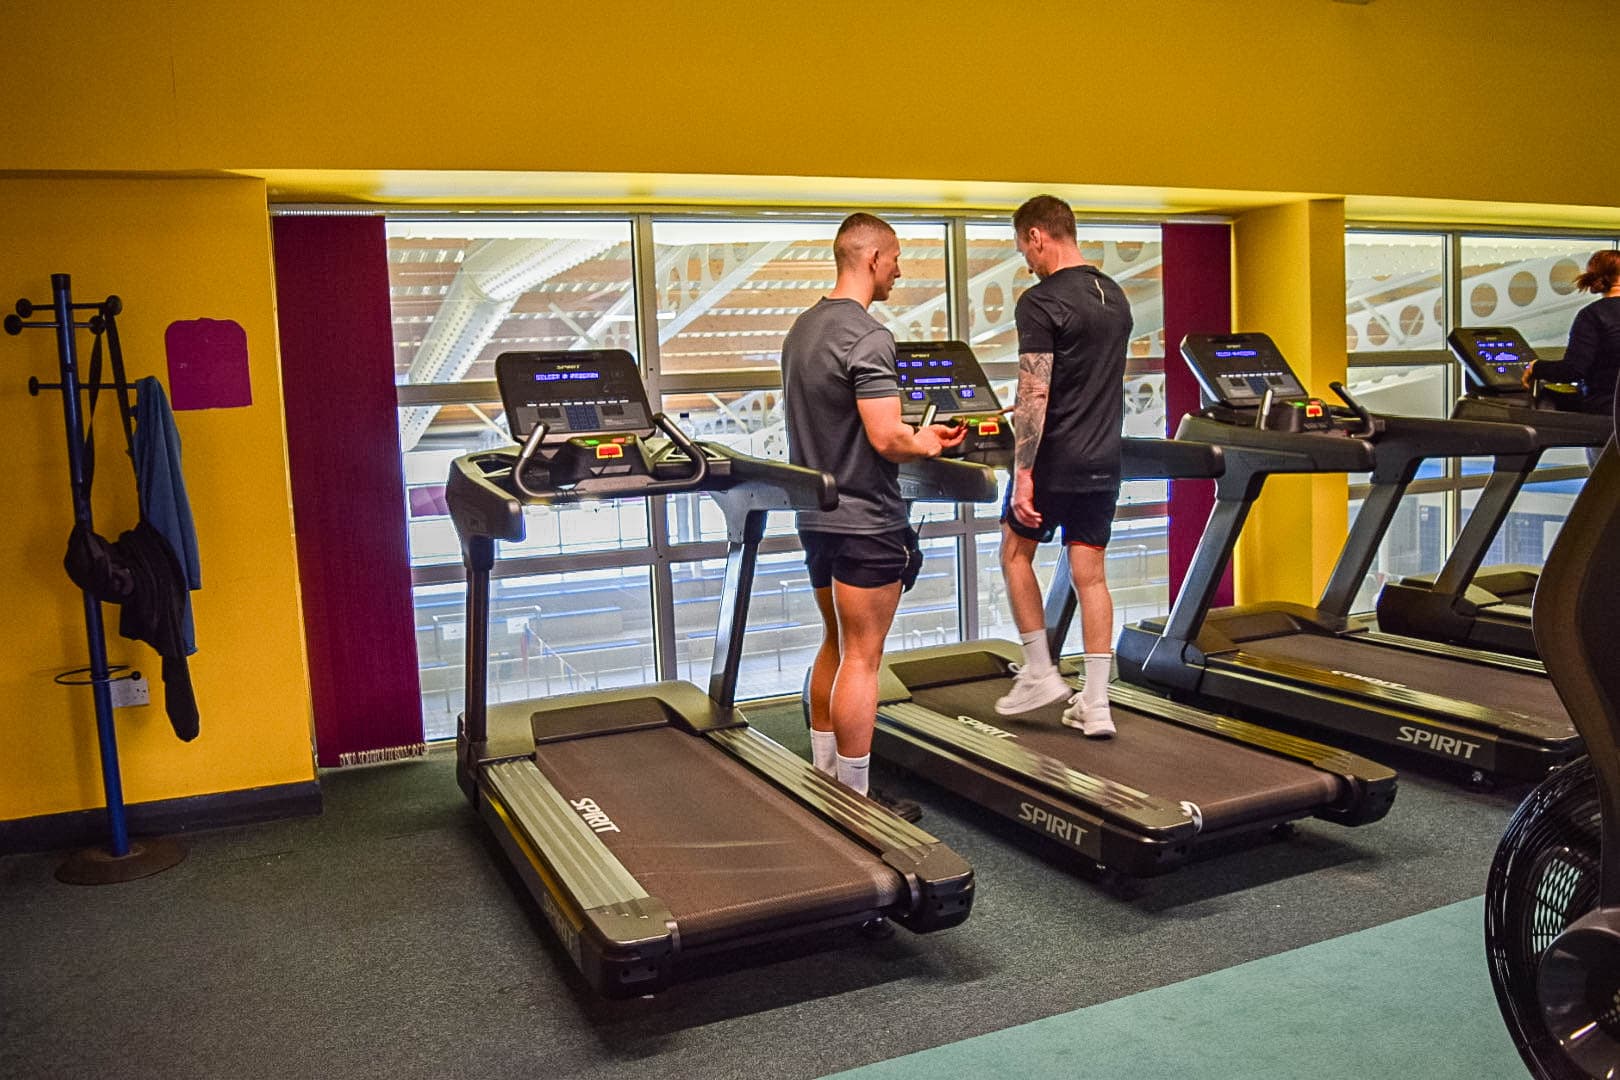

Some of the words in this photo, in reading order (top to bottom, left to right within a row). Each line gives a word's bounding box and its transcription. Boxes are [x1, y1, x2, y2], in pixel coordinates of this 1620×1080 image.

[1396, 726, 1480, 759] SPIRIT
[570, 797, 621, 833] SPIRIT
[1018, 802, 1088, 846] SPIRIT
